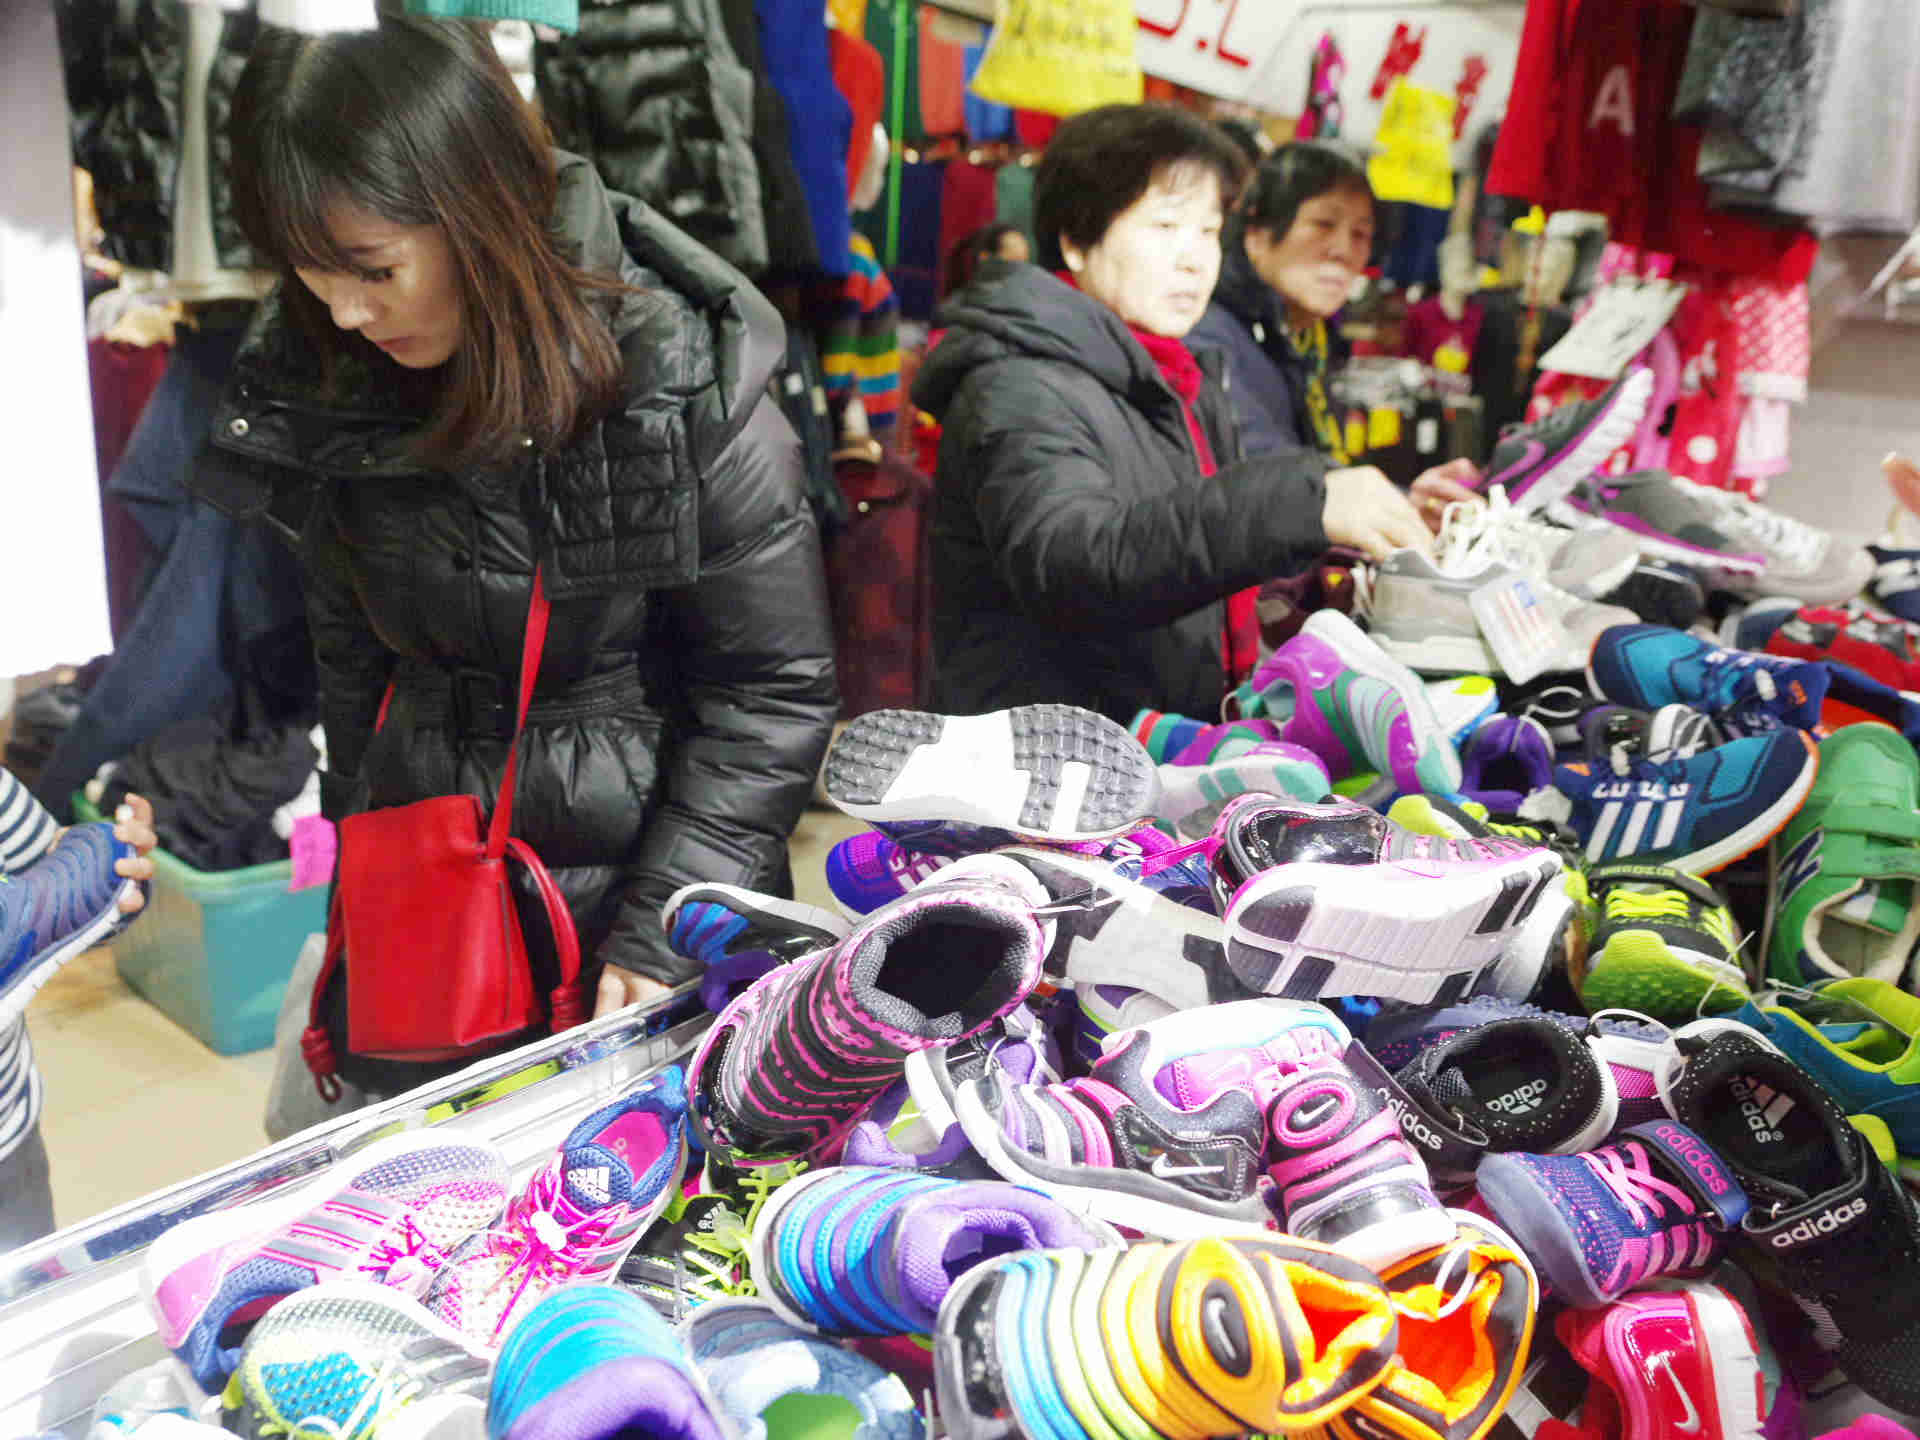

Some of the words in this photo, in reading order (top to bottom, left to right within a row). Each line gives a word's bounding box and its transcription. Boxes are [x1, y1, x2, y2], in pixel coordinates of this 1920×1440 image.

[1485, 1078, 1547, 1111] adida
[1730, 1075, 1772, 1143] didas
[1655, 1125, 1729, 1195] adidas
[1771, 1197, 1868, 1248] adidas
